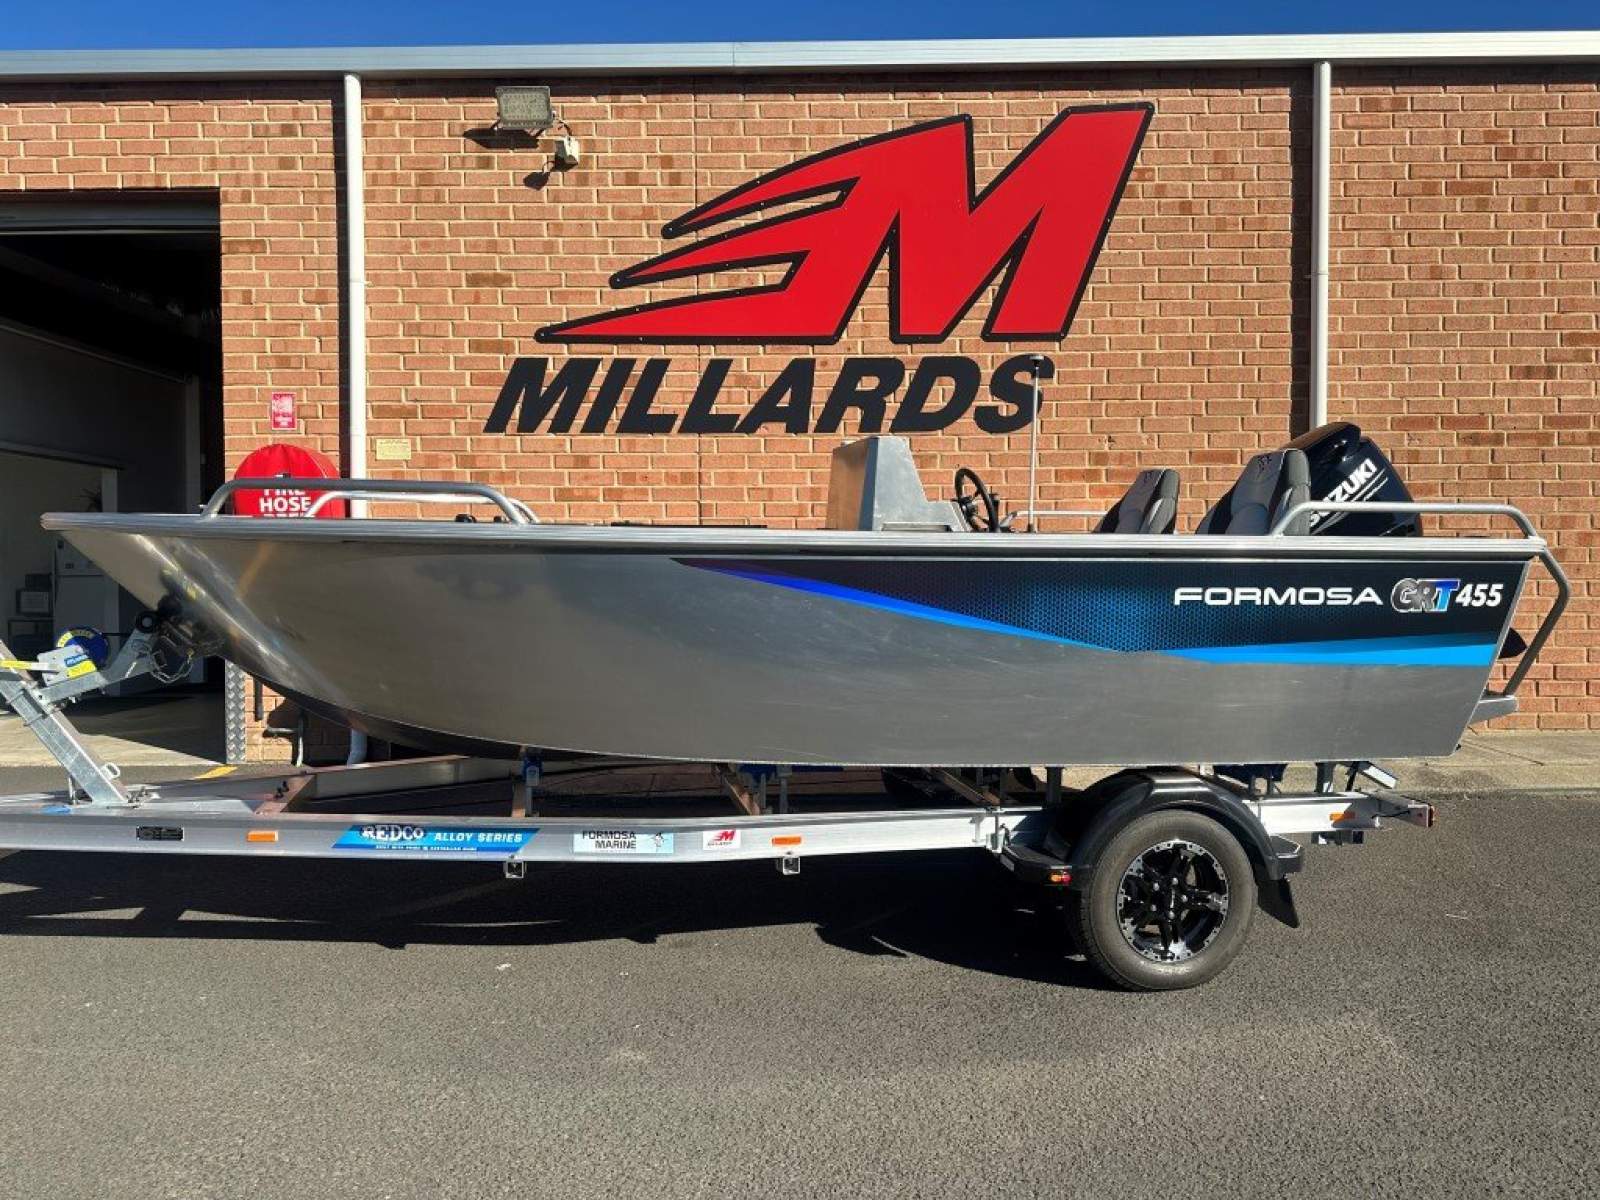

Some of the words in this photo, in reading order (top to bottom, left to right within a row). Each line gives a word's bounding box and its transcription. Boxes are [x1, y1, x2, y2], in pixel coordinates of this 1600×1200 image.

[483, 355, 1055, 435] MILLARDS
[259, 496, 312, 512] HOSE
[1173, 587, 1384, 607] FORMOSA
[1390, 577, 1460, 613] GRT
[1455, 583, 1504, 607] 455
[434, 832, 472, 842] ALLOY
[477, 833, 523, 844] SERIES
[582, 830, 637, 840] FORMOSA
[594, 840, 637, 849] MARINE
